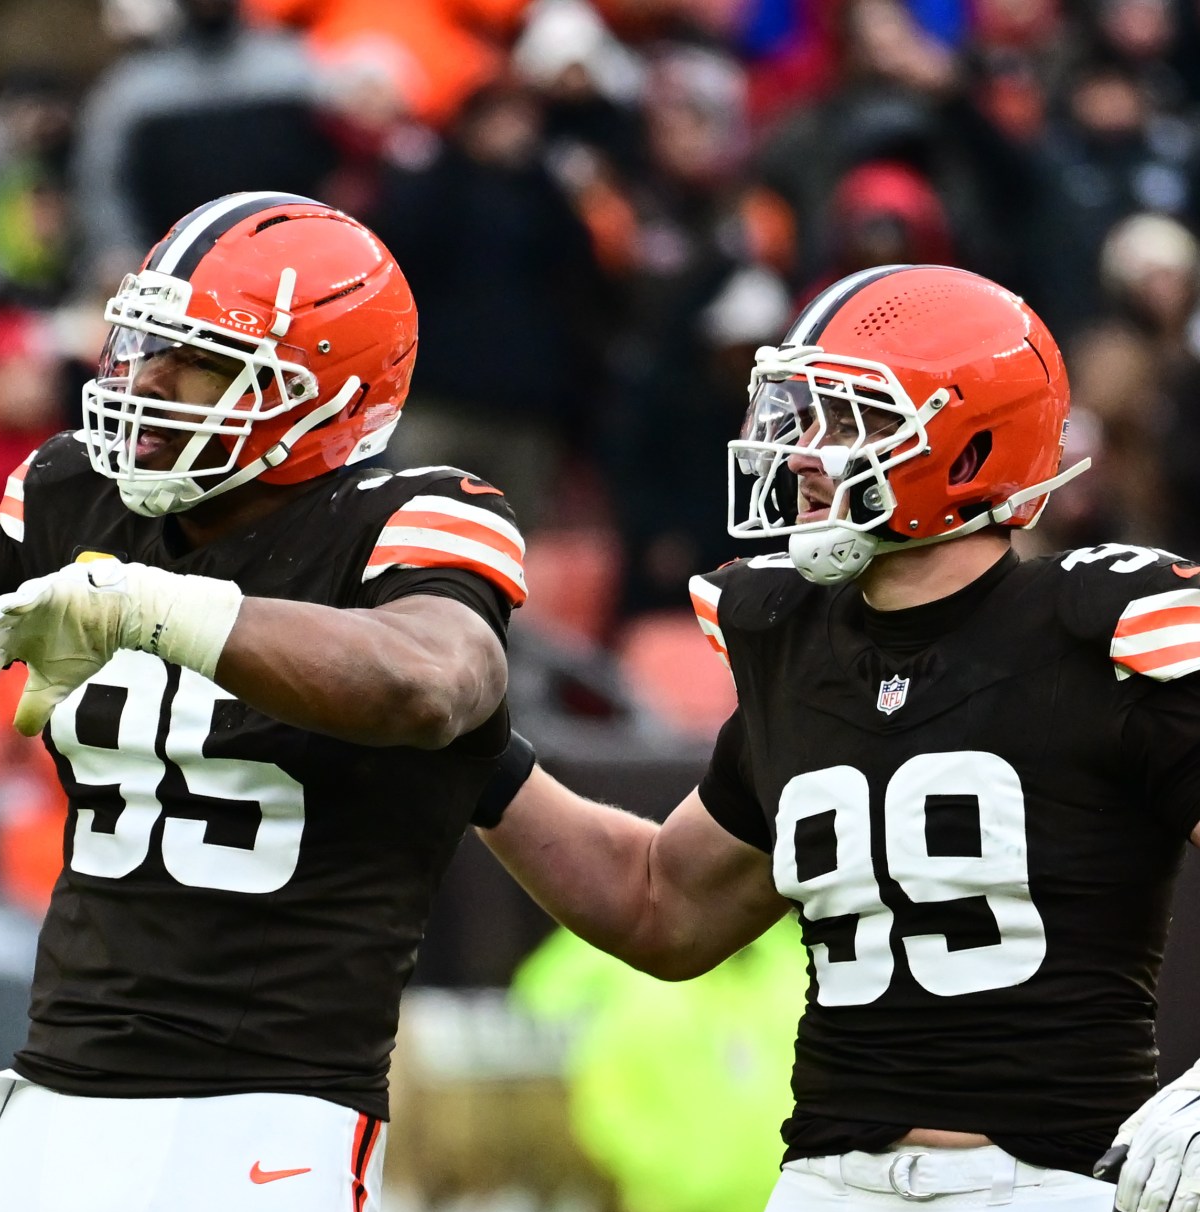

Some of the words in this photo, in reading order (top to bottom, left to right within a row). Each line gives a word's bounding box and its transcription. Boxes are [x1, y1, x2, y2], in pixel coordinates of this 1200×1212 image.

[219, 317, 263, 335] OAKLEY
[882, 691, 901, 707] NFL
[51, 650, 304, 893] 95
[773, 750, 1046, 1007] 99
